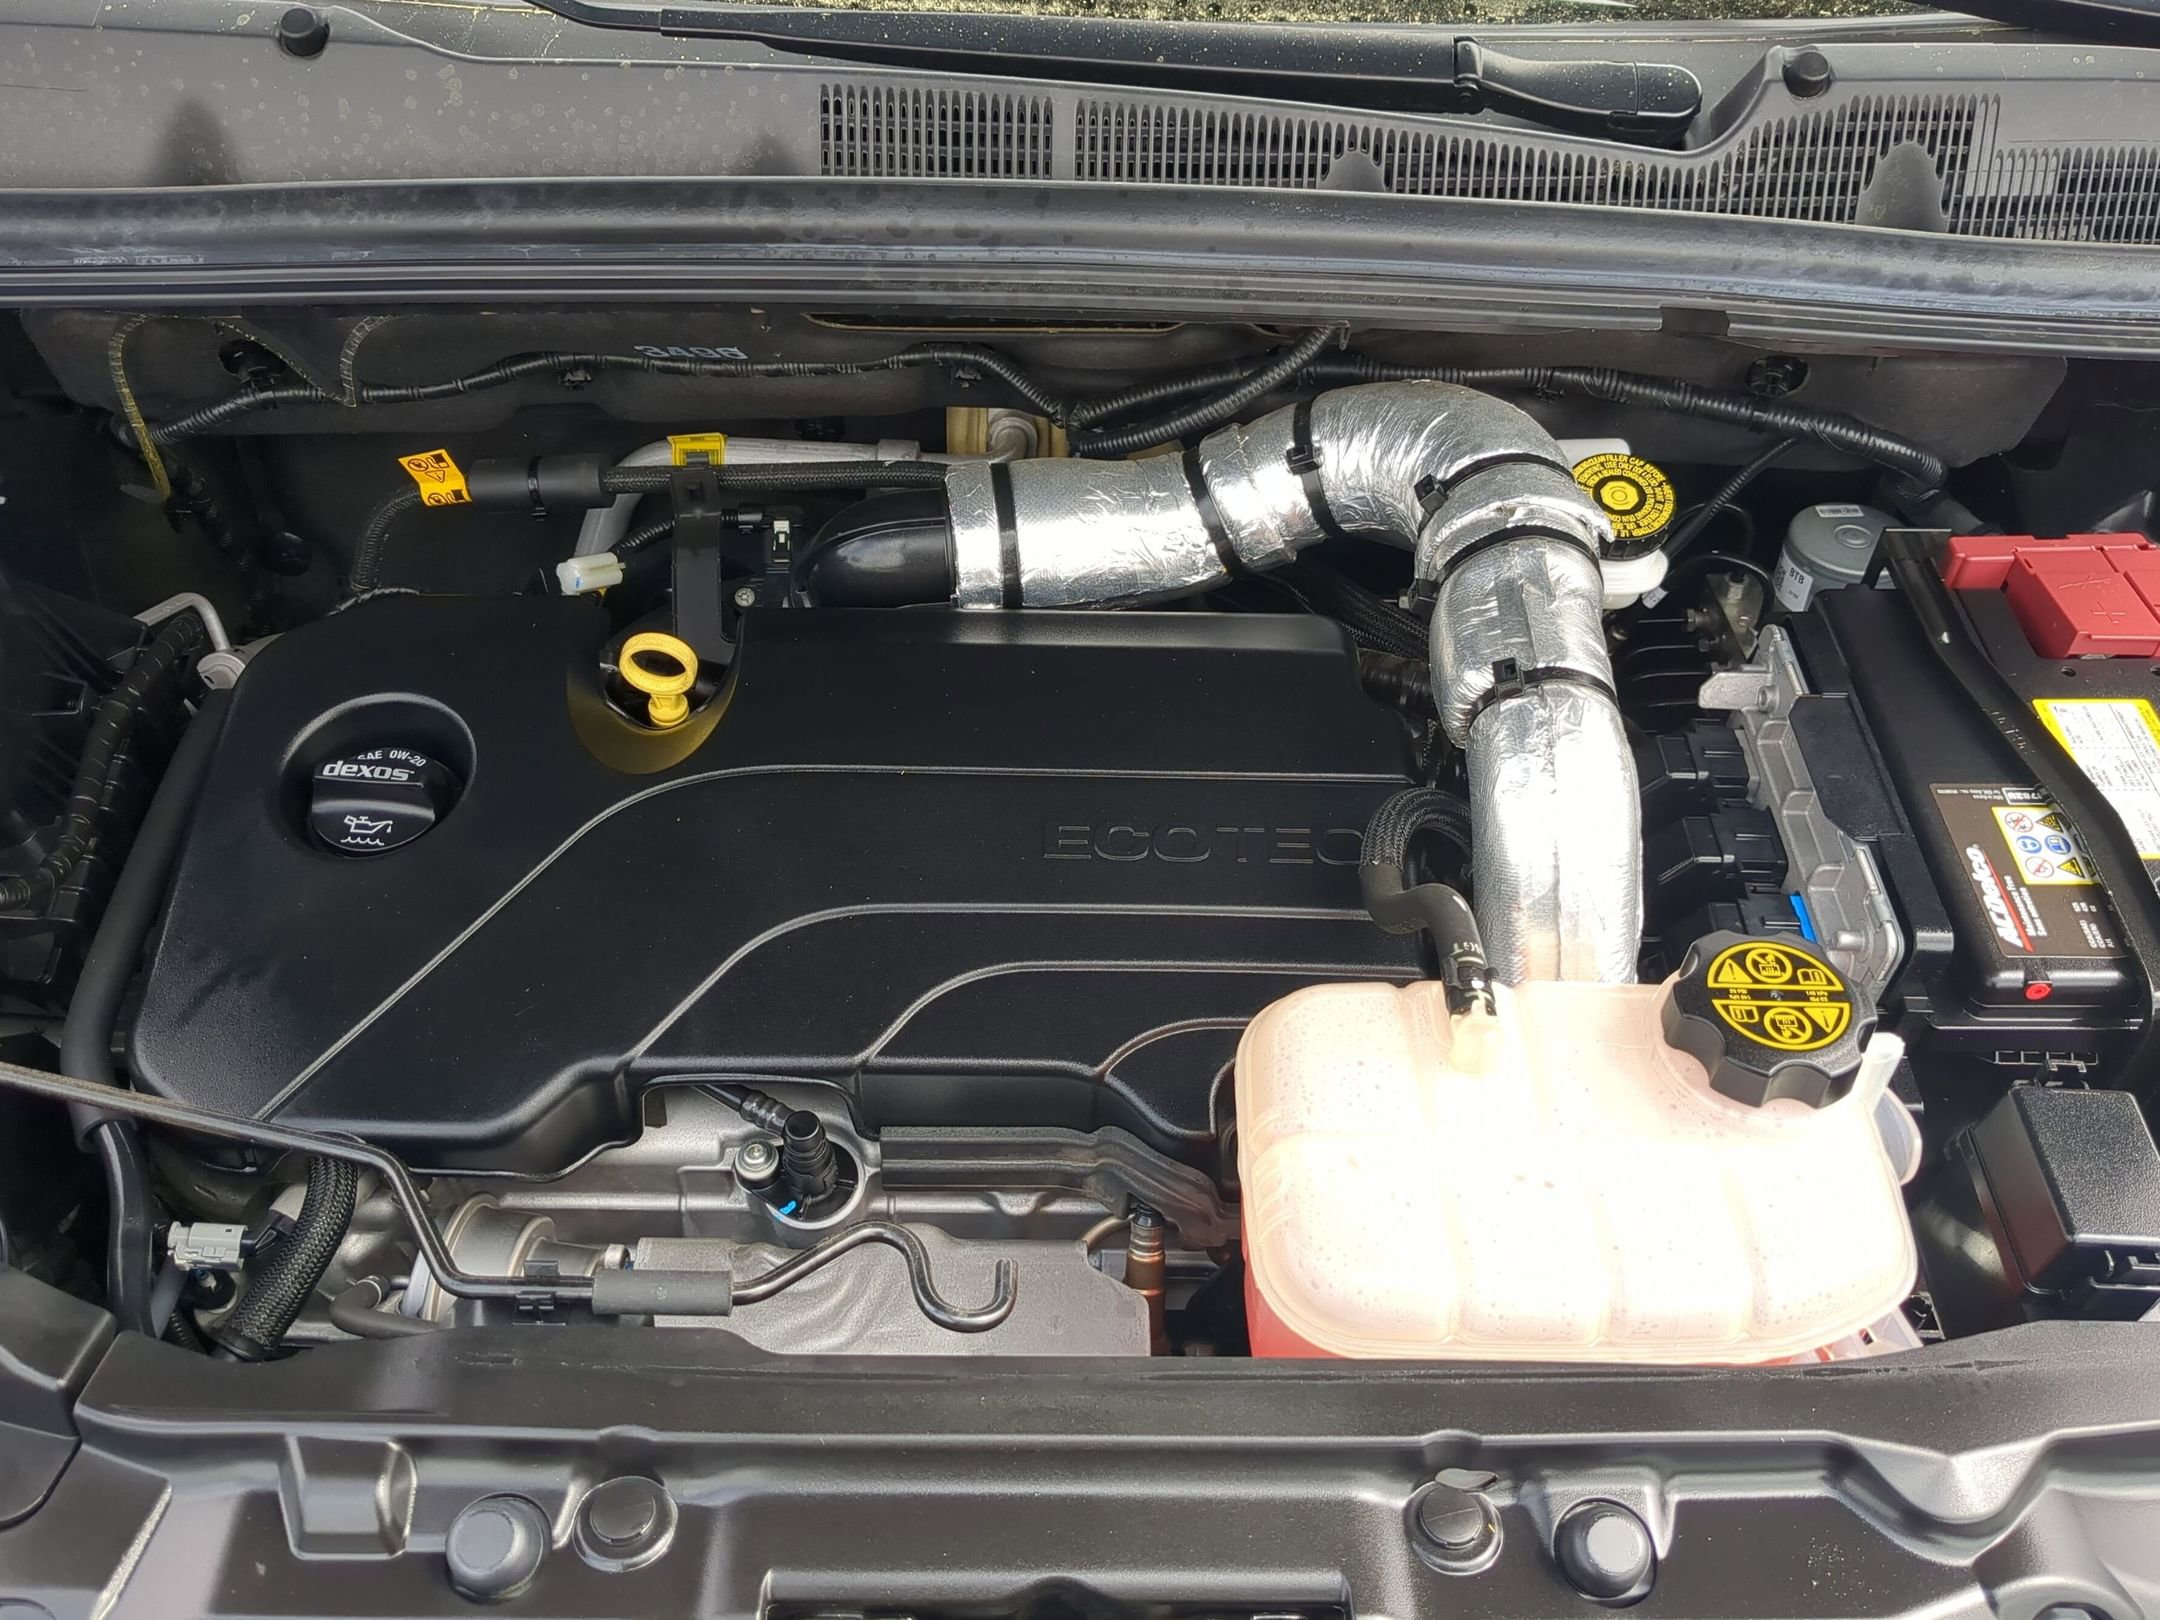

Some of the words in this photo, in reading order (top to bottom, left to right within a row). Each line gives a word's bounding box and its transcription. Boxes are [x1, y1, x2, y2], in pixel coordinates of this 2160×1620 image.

[1629, 457, 1645, 467] CAP
[1790, 567, 1804, 584] BTB
[389, 750, 426, 767] 0W-20
[323, 760, 410, 781] dexos
[1966, 846, 2024, 948] ACDelco
